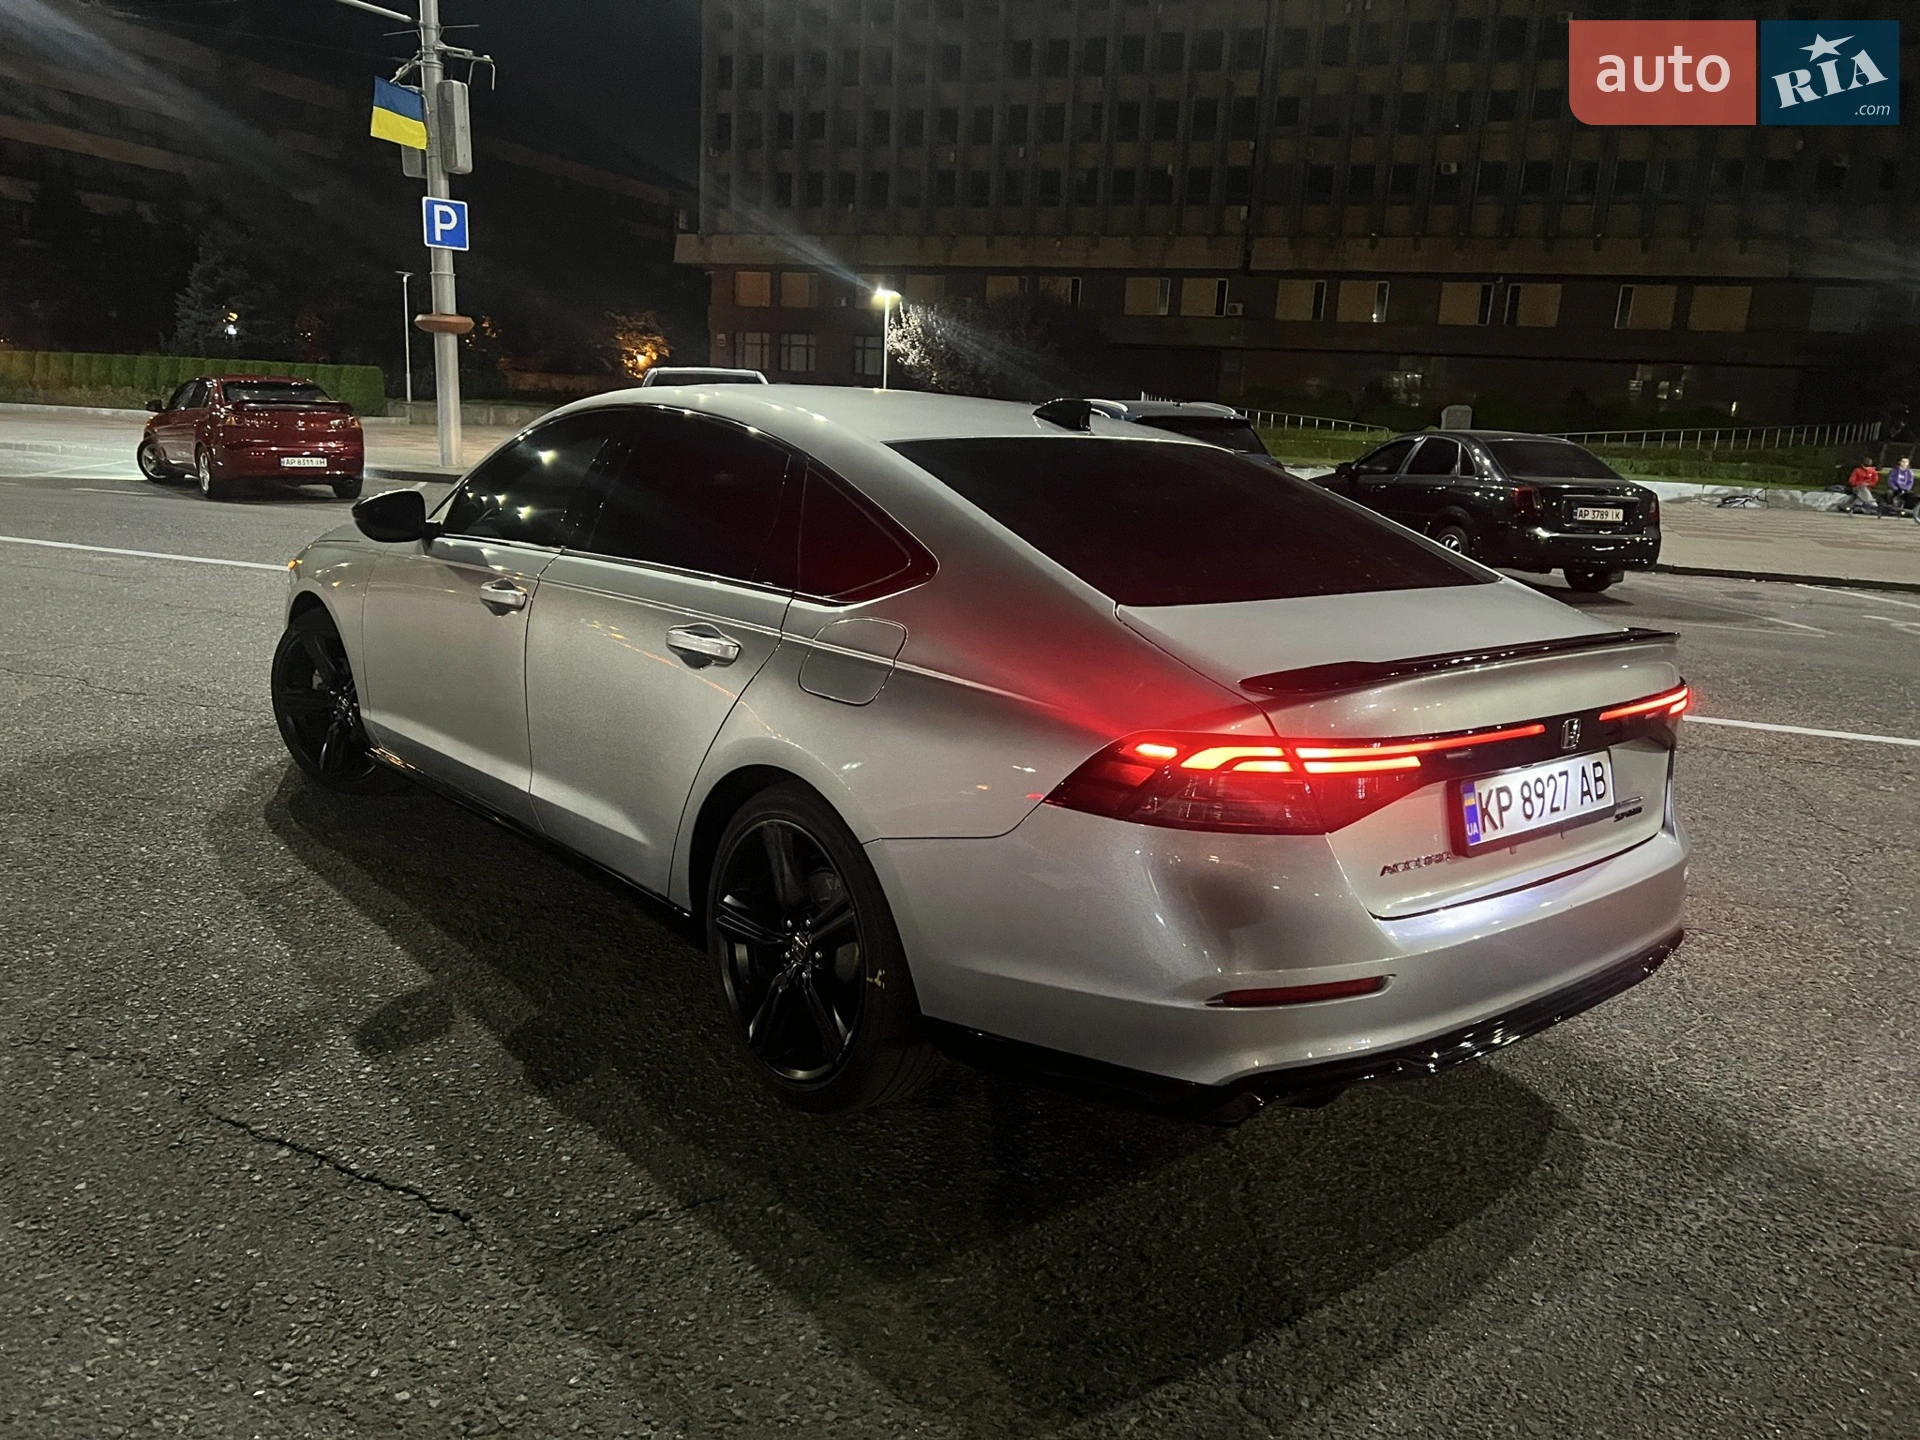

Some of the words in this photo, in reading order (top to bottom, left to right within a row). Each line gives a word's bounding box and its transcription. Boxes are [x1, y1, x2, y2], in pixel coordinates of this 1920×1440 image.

[434, 204, 457, 241] P
[1579, 509, 1589, 519] AP
[1591, 510, 1608, 519] 3789
[1611, 511, 1620, 520] IK
[1478, 785, 1513, 833] KP
[1520, 770, 1569, 821] 8927
[1580, 761, 1607, 805] AB
[1467, 823, 1479, 836] UA
